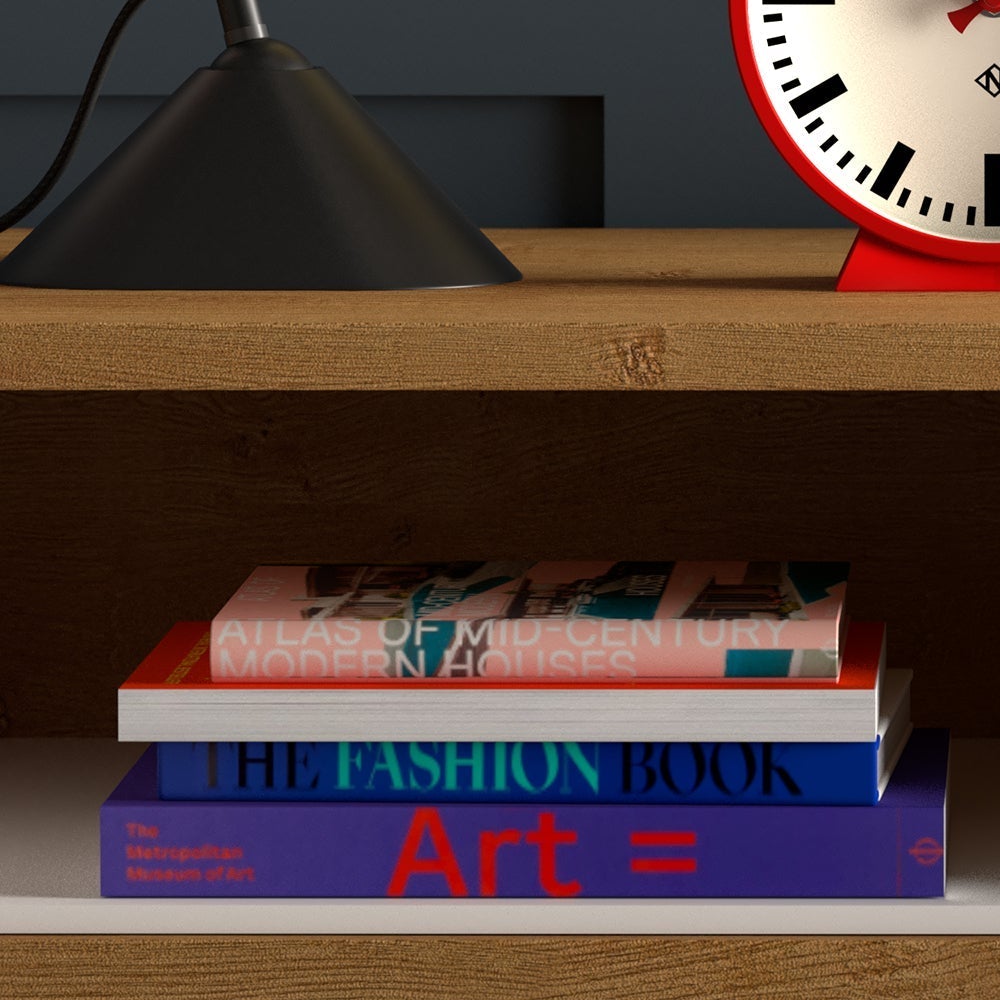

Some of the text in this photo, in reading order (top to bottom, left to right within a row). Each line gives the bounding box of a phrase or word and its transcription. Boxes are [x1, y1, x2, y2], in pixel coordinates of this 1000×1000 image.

[217, 618, 789, 648] ATLAS OF MID-CENTURY
[219, 648, 425, 677] MODERN
[436, 649, 637, 677] HOUSES
[192, 741, 803, 796] THE FASHION BOOK
[126, 823, 159, 838] The
[126, 844, 243, 862] Metropolitan
[386, 805, 582, 897] Art
[126, 866, 255, 881] Museum of Art
